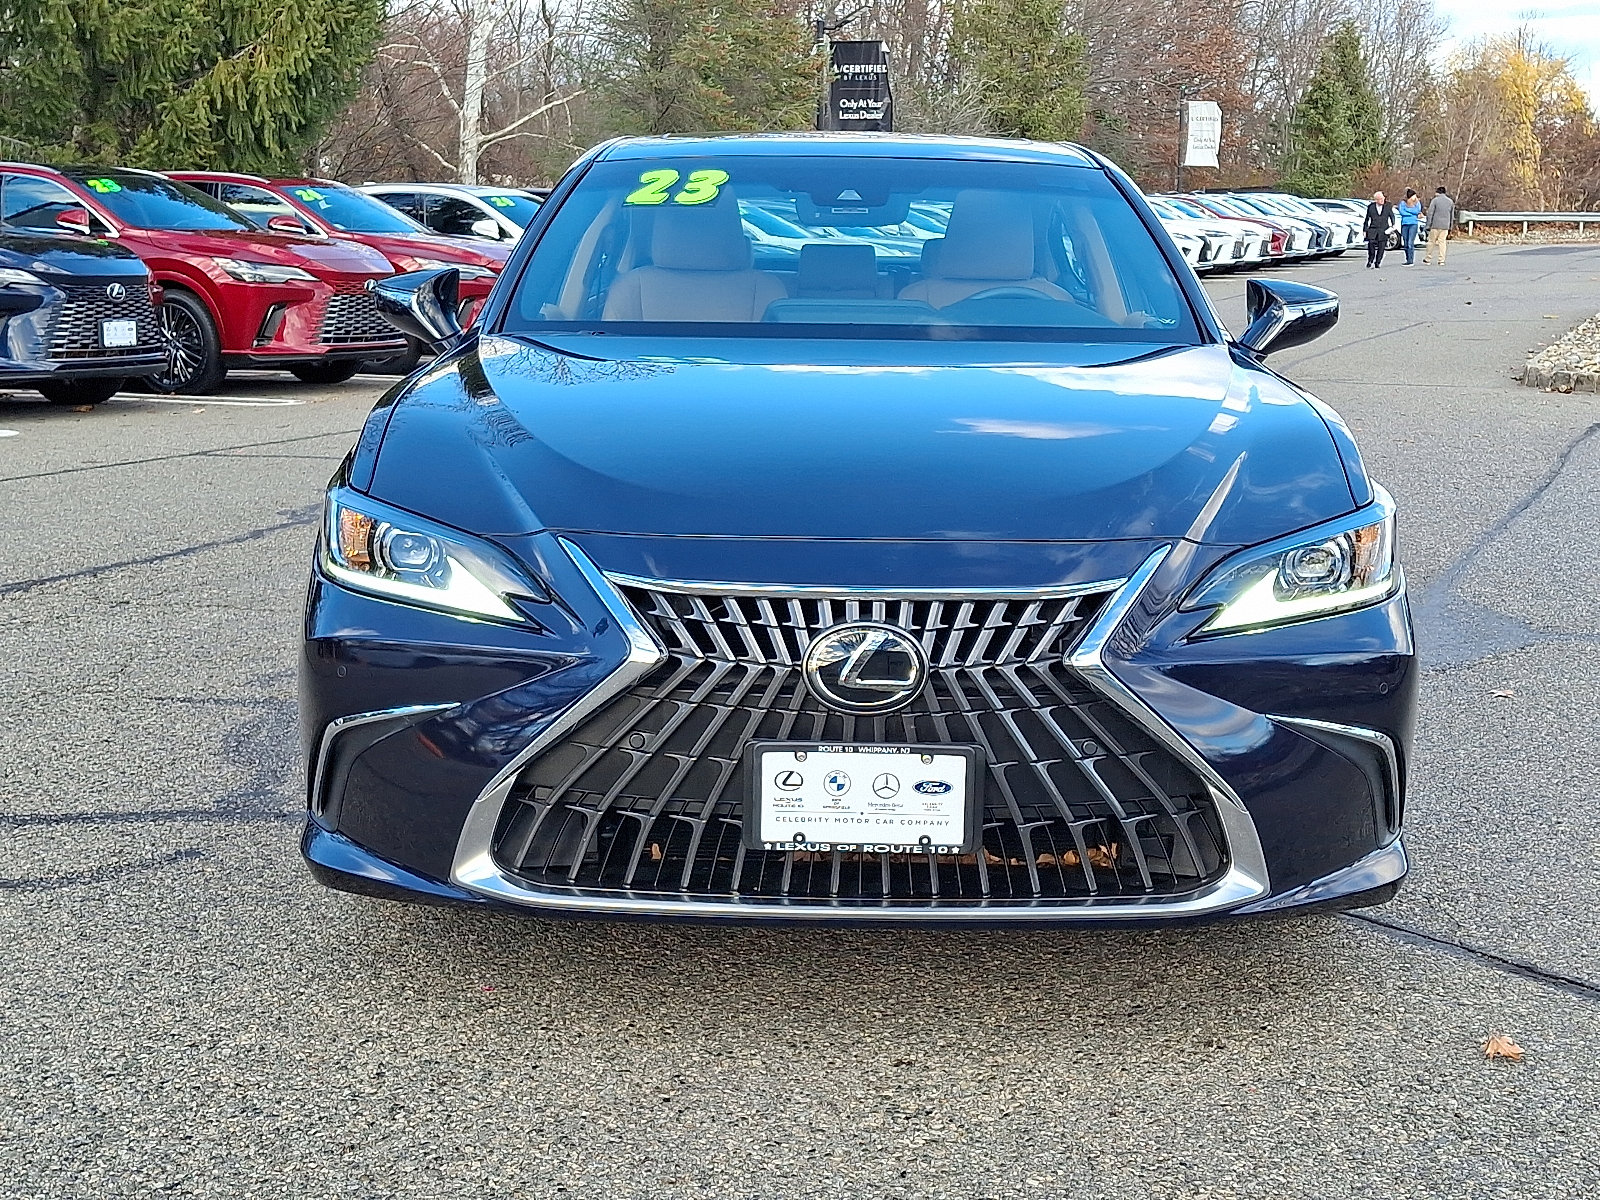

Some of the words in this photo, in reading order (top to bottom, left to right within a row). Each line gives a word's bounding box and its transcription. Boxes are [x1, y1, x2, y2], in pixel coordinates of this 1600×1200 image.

[839, 98, 858, 109] Only
[858, 98, 867, 108] At
[867, 98, 884, 108] Your
[839, 110, 859, 119] Lexus
[860, 110, 884, 119] Dealer
[625, 168, 730, 206] 23
[818, 745, 843, 753] ROUTE
[920, 782, 946, 793] Ford
[776, 842, 831, 852] LEXUS
[836, 844, 857, 852] OF
[863, 845, 923, 854] ROUTE
[928, 846, 948, 854] 10
